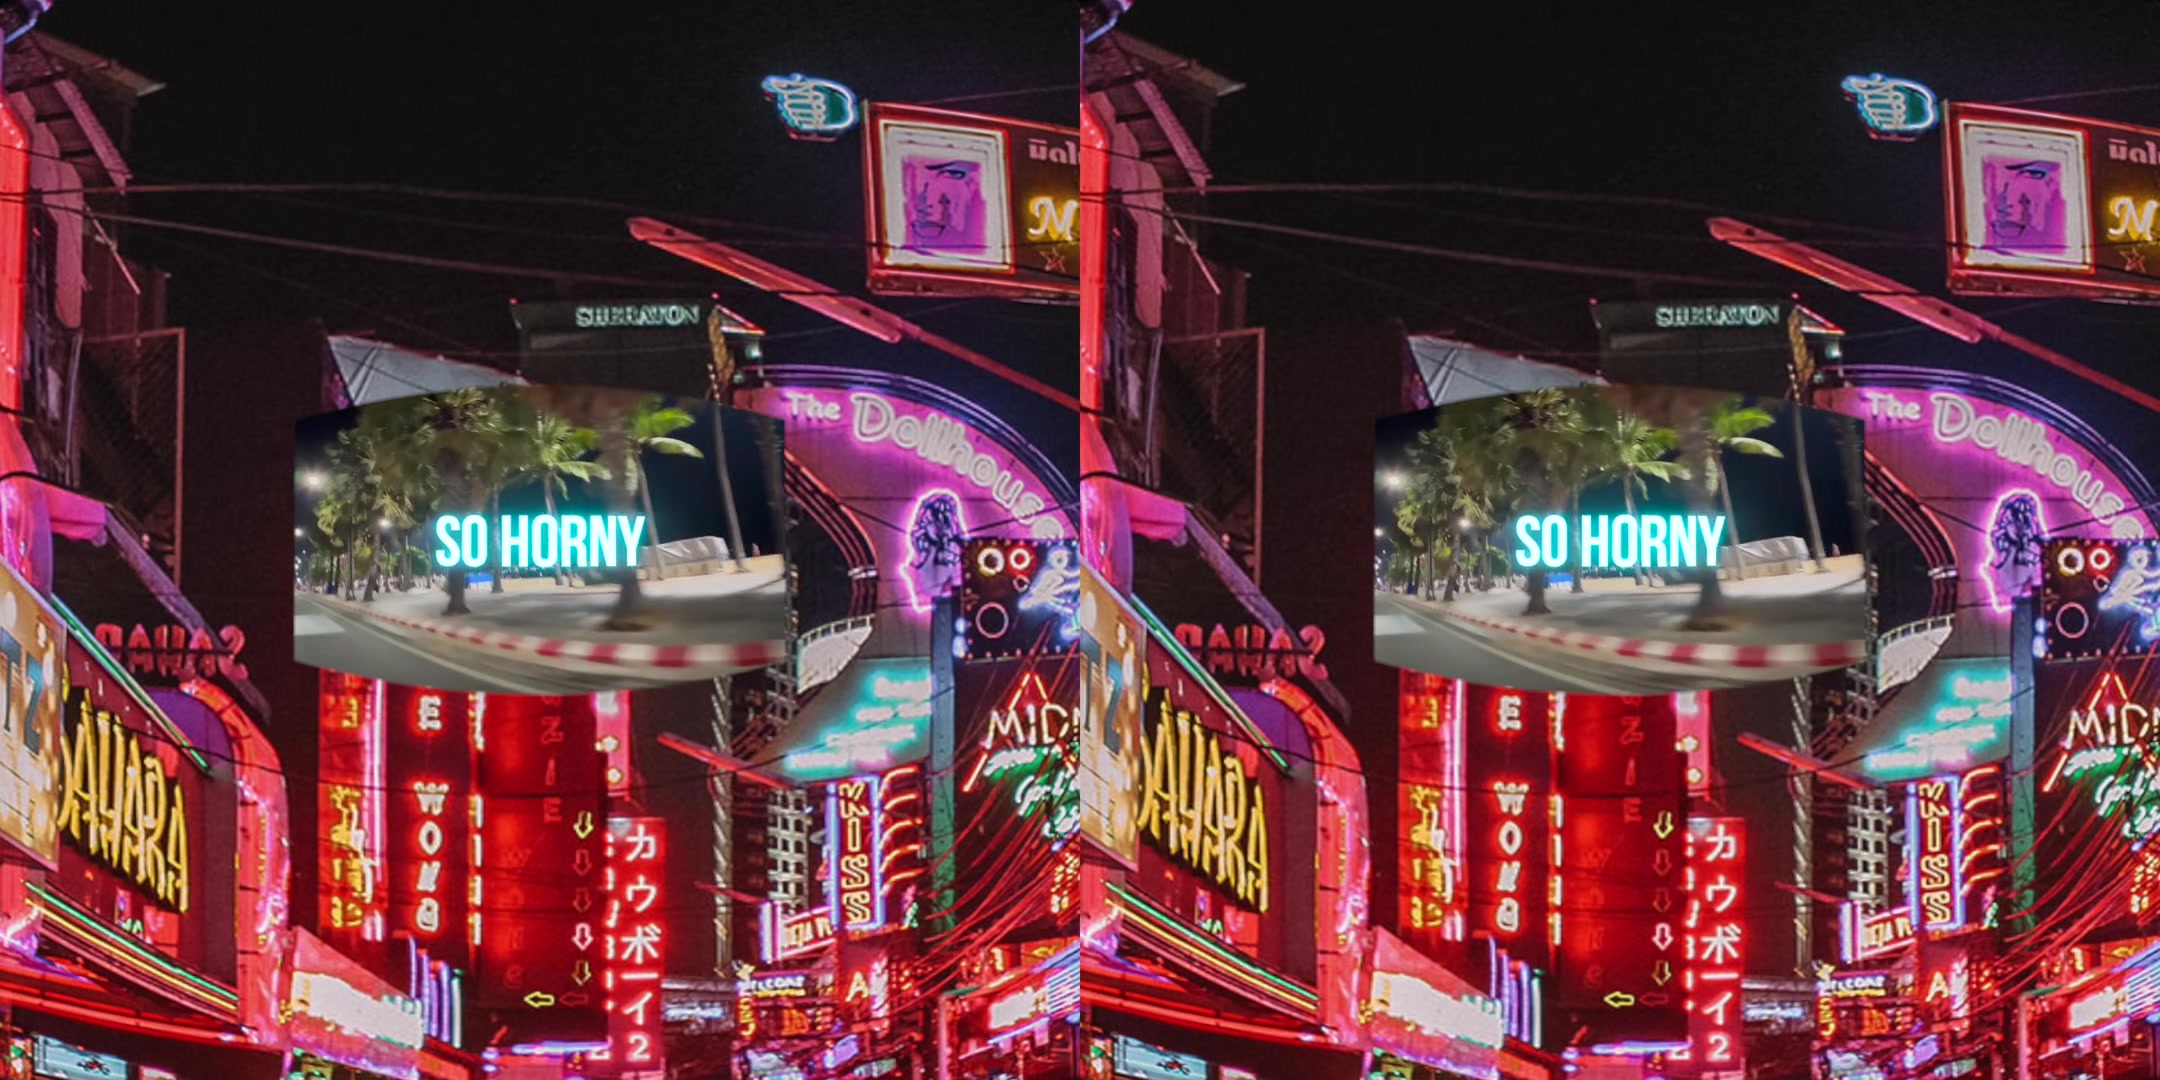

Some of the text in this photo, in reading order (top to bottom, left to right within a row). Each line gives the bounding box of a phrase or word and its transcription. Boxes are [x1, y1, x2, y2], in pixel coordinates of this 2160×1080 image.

[576, 305, 700, 327] SHERATON
[1656, 305, 1780, 327] SHERATON
[784, 391, 841, 420] The
[1864, 391, 1921, 420] The
[838, 781, 872, 925] KISS
[1918, 781, 1952, 925] KISS
[621, 824, 662, 1061] カウボーイ2
[1701, 824, 1742, 1061] カウボーイ2
